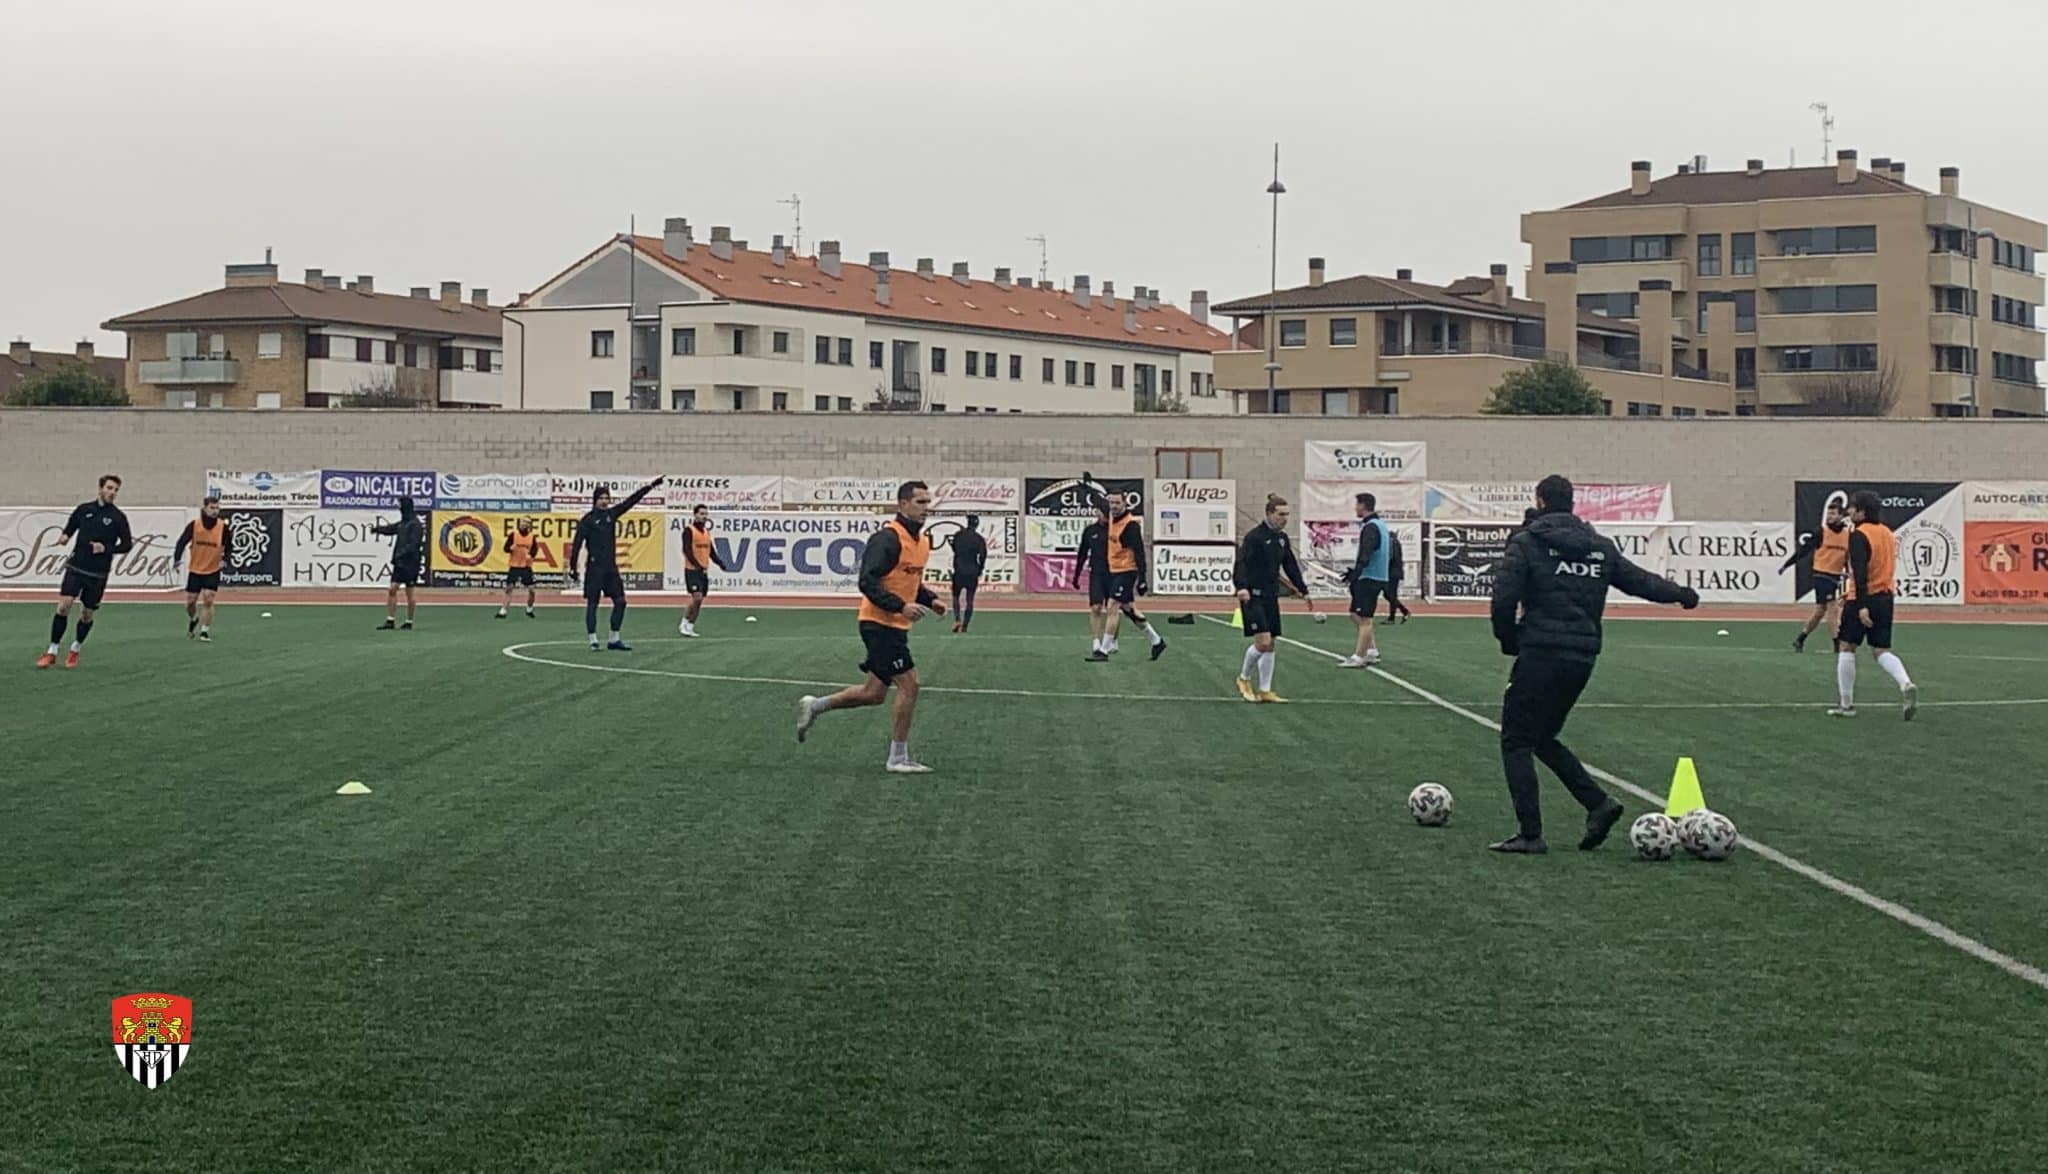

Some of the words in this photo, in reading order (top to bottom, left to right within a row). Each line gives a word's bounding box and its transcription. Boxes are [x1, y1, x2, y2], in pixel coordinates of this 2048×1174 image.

[355, 476, 433, 496] INCALTEC
[667, 478, 730, 489] TALLERES
[219, 492, 288, 501] Instalaciones
[814, 489, 896, 501] CLAVEL
[1162, 482, 1228, 503] Muga
[325, 496, 378, 506] RADIADORES
[1029, 506, 1050, 516] bar
[670, 518, 843, 533] AUO-REPARACIONES
[1006, 517, 1016, 551] HARO
[0, 525, 174, 578] Salba
[714, 537, 867, 575] VECO
[294, 562, 394, 582] HYDRA
[1157, 568, 1232, 582] VELASCO
[1554, 560, 1601, 578] ADE
[220, 572, 273, 584] hydragora
